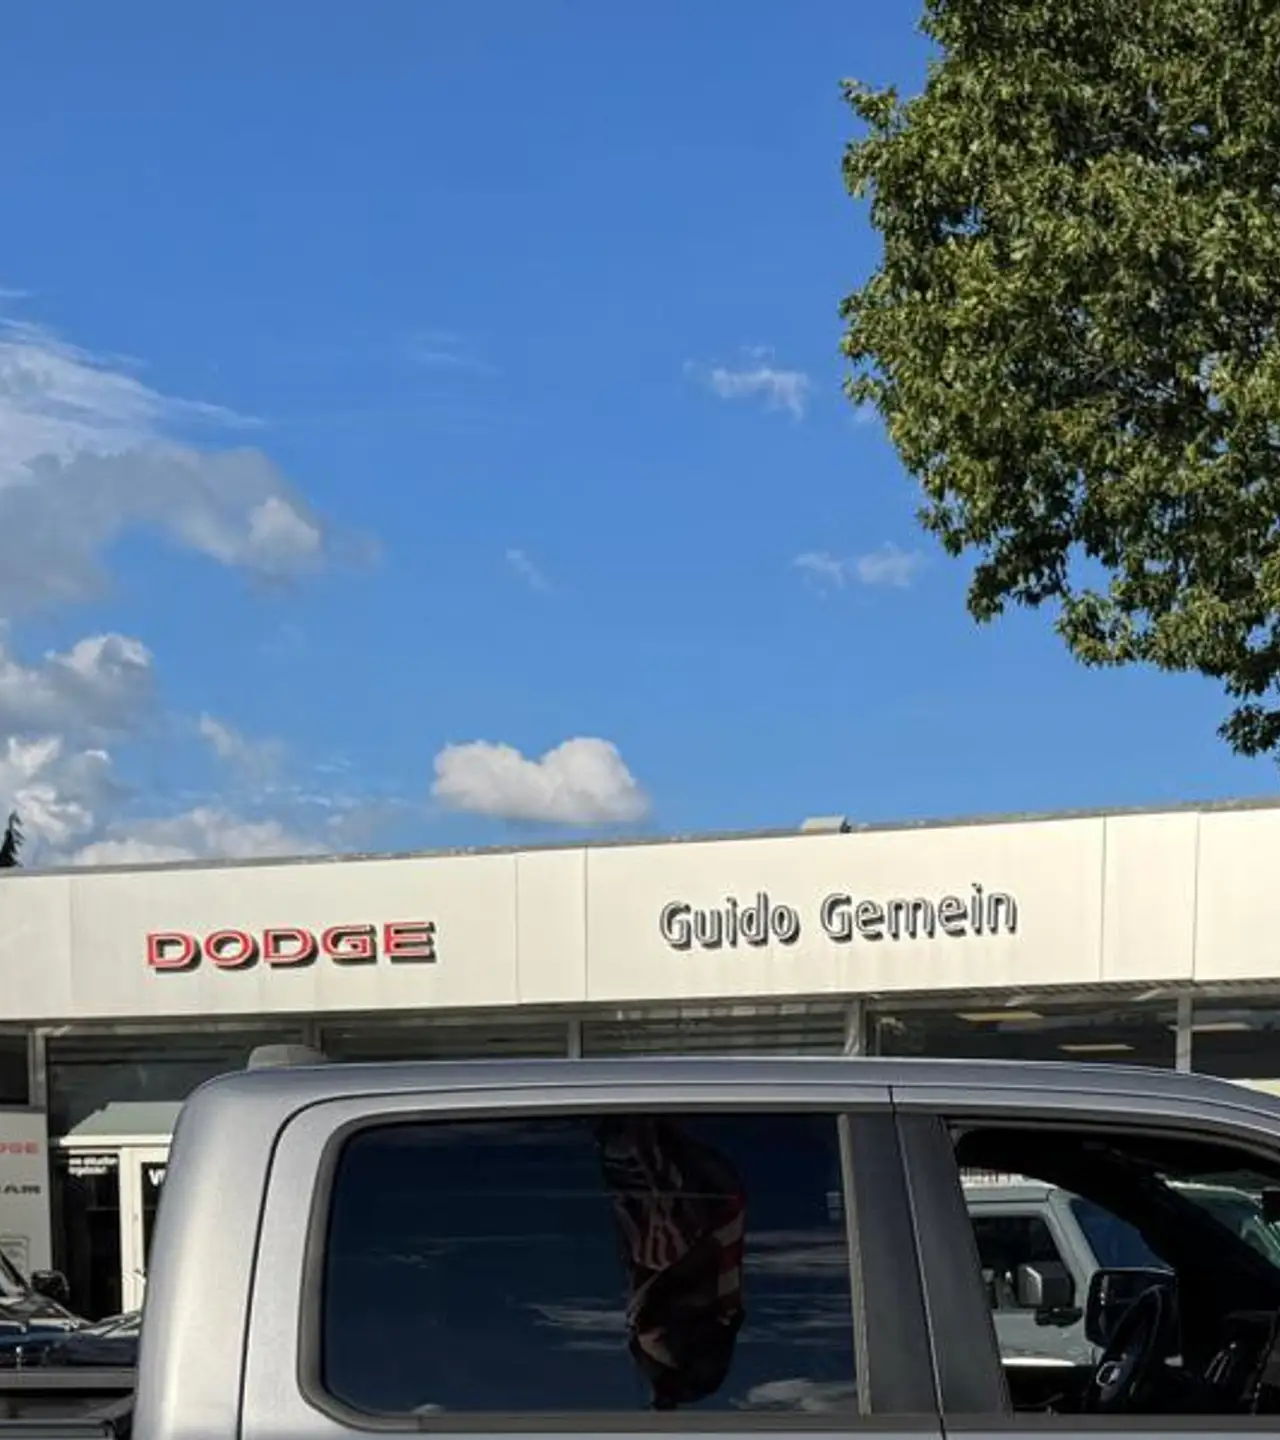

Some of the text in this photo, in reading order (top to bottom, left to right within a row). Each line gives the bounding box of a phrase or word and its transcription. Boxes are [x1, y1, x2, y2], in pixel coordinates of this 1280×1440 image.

[146, 920, 437, 972] DODGE
[659, 883, 1018, 951] Guido Gemein
